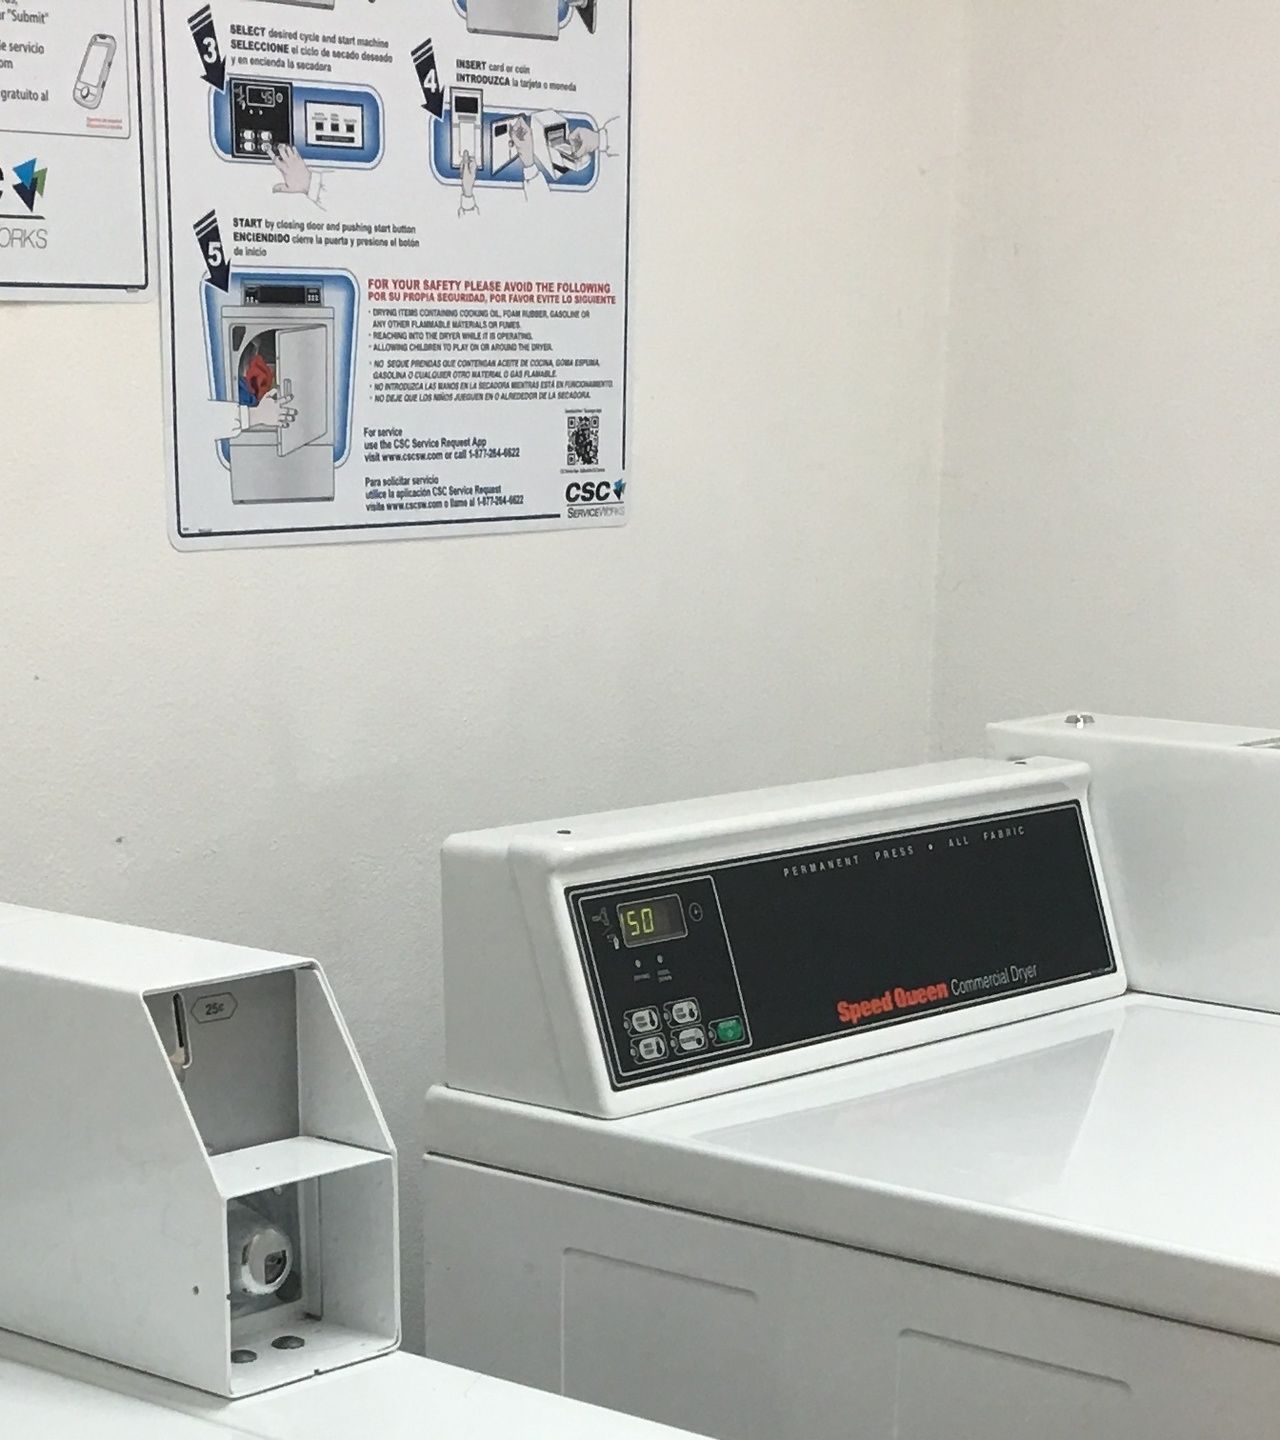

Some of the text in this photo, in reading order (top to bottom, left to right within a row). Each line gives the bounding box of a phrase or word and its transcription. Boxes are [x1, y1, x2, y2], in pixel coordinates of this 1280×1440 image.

[229, 23, 389, 48] SELECT desired cycle and start machine
[8, 41, 44, 54] servicio
[202, 37, 218, 63] 3
[229, 39, 289, 53] SELECCIONE
[455, 58, 530, 74] INSERT card or coin
[423, 69, 437, 93] 4
[455, 72, 510, 86] INTRODUZCA
[0, 88, 39, 102] gratuito
[39, 89, 49, 102] al
[208, 241, 222, 266] 5
[367, 278, 611, 293] FOR YOUR SAFETY PLEASE AVOID THE FOLLOWING
[362, 426, 403, 437] For service
[565, 481, 611, 503] CSC
[783, 826, 1025, 878] PERMANENT PRESS ALL FABRIC
[837, 963, 1038, 1024] Speed Queen Commercial Dryer
